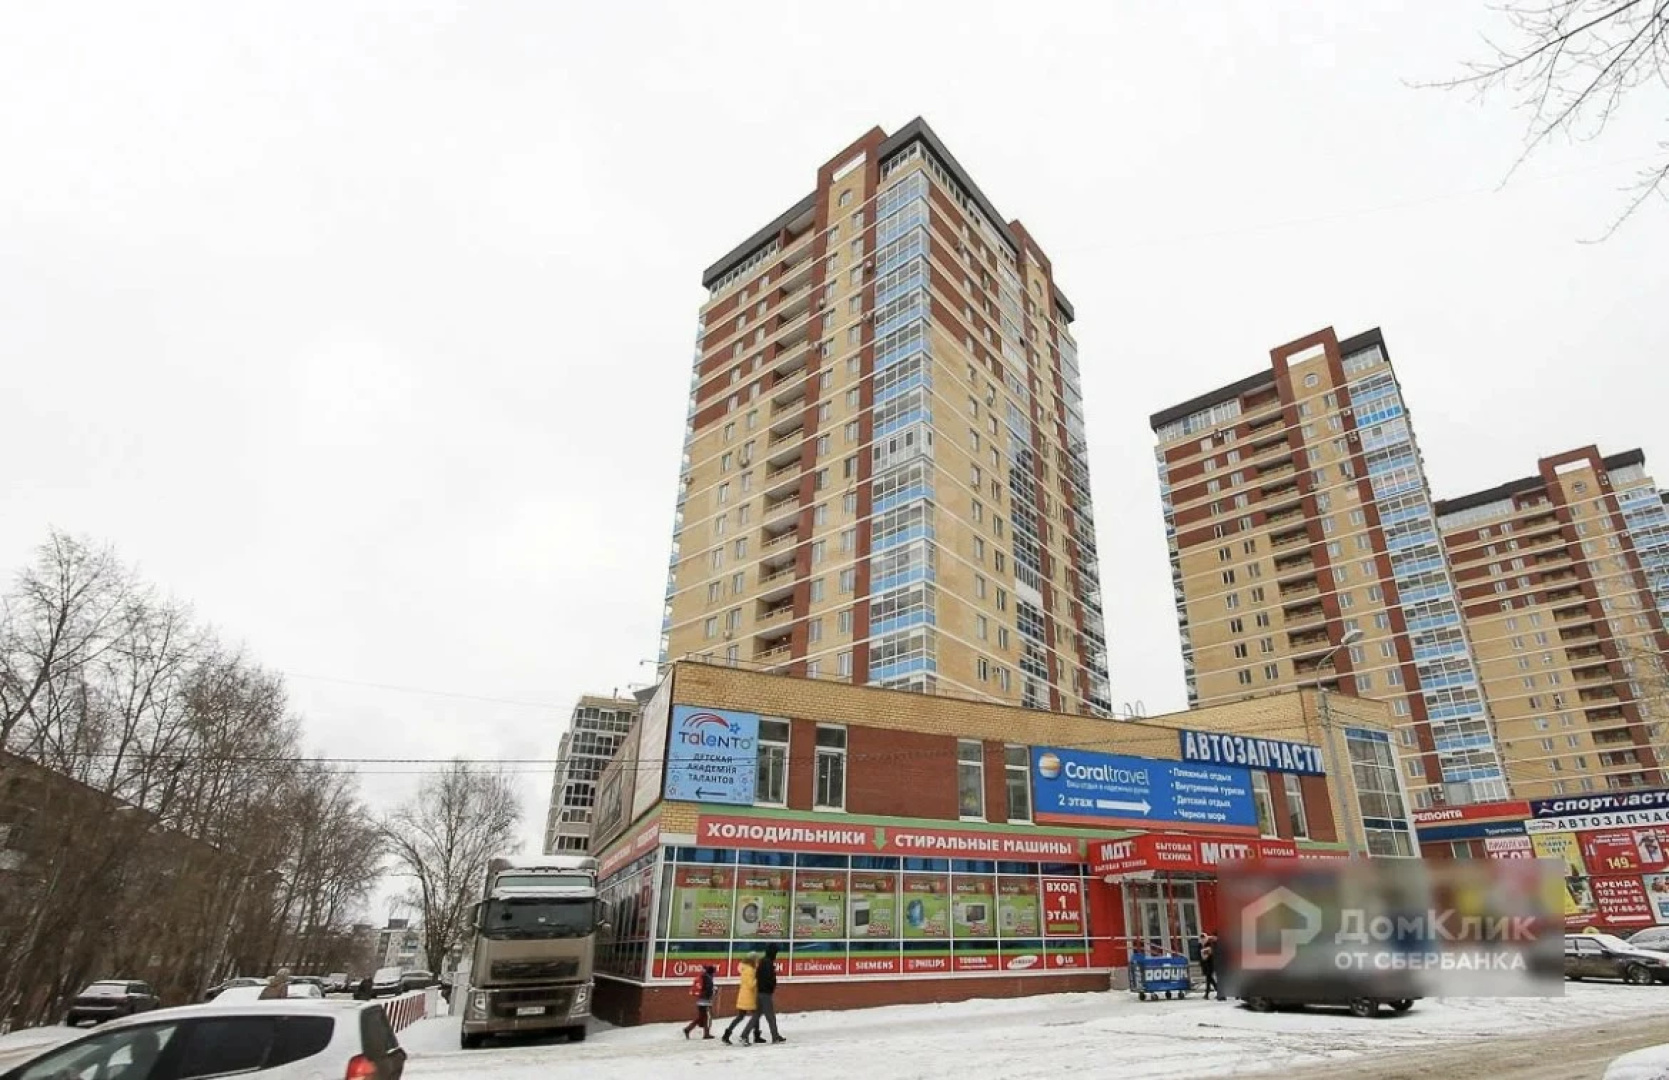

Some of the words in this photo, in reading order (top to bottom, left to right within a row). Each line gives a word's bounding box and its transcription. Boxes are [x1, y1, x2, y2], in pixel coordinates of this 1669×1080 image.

[1186, 731, 1325, 772] АВТОЗАПЧАСТИ
[694, 753, 733, 763] ДЕТСКАЯ
[688, 763, 737, 774] АКАДЕМИЯ
[689, 774, 734, 784] ТАЛАНТОВ
[1058, 793, 1065, 806] 2
[1068, 797, 1094, 807] этаж
[707, 822, 865, 845] ХОЛОДИЛЬНИКИ
[895, 834, 999, 851] СТИРАЛЬНЫЕ
[1004, 838, 1072, 854] МАШИНЫ
[1155, 842, 1192, 851] БЫТОВАЯ
[1157, 851, 1192, 861] ТЕХНИКА
[1262, 847, 1294, 857] БЫТОВАЯ
[1606, 856, 1630, 869] 149
[1046, 882, 1077, 894] ВХОД
[1595, 880, 1640, 889] АРЕНДА
[1058, 895, 1067, 909] 1
[1046, 910, 1079, 921] ЭТАЖ
[855, 960, 893, 970] SIEMENS
[915, 958, 945, 969] PHILIPS
[1065, 955, 1074, 964] LG
[804, 961, 842, 971] Electrolux
